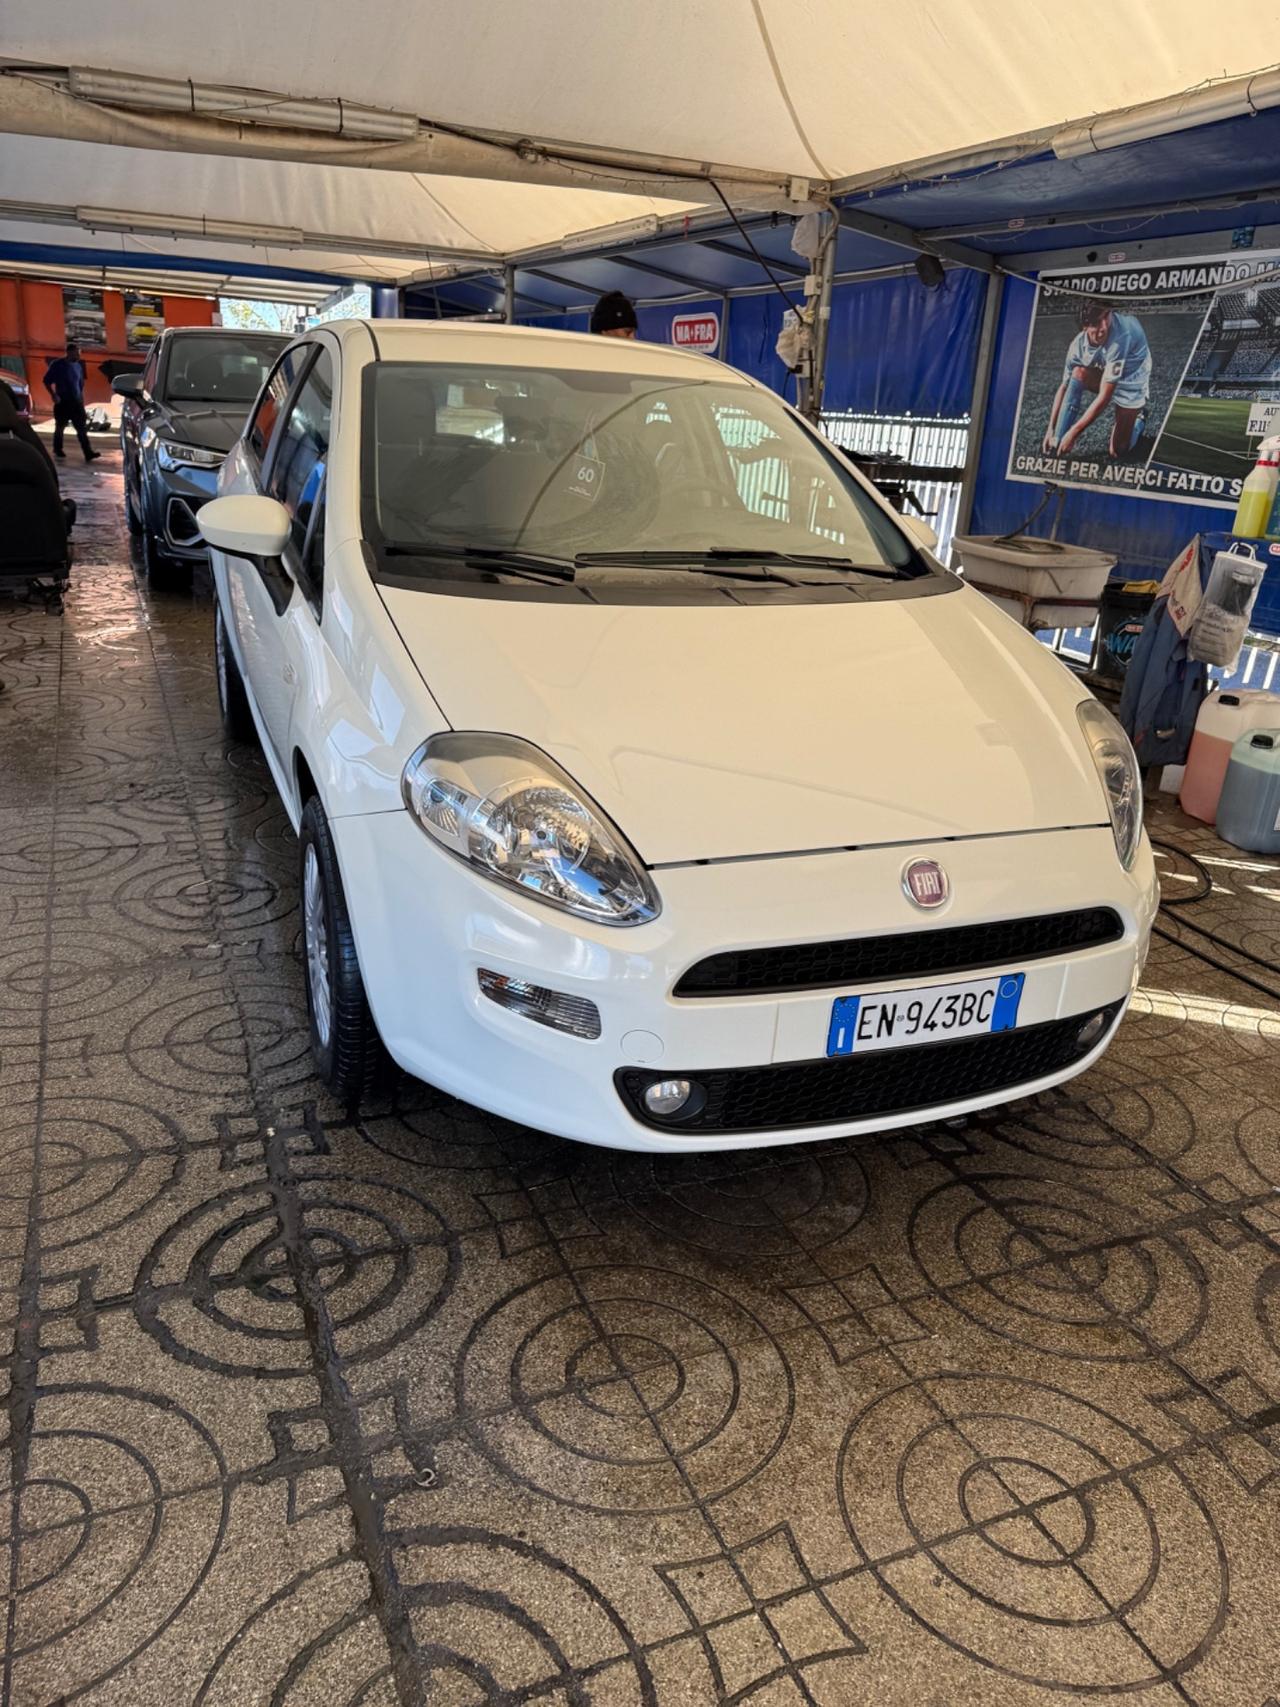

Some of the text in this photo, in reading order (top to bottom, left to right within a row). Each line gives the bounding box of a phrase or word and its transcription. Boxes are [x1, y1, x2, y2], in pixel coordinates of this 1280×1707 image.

[1100, 271, 1152, 294] DIEGO
[1155, 263, 1251, 290] ARMANDO
[1264, 407, 1280, 416] AU
[577, 466, 594, 483] 60
[1016, 456, 1243, 496] GRAZIE PER AVERCI FATTO S
[913, 870, 942, 897] FIAT
